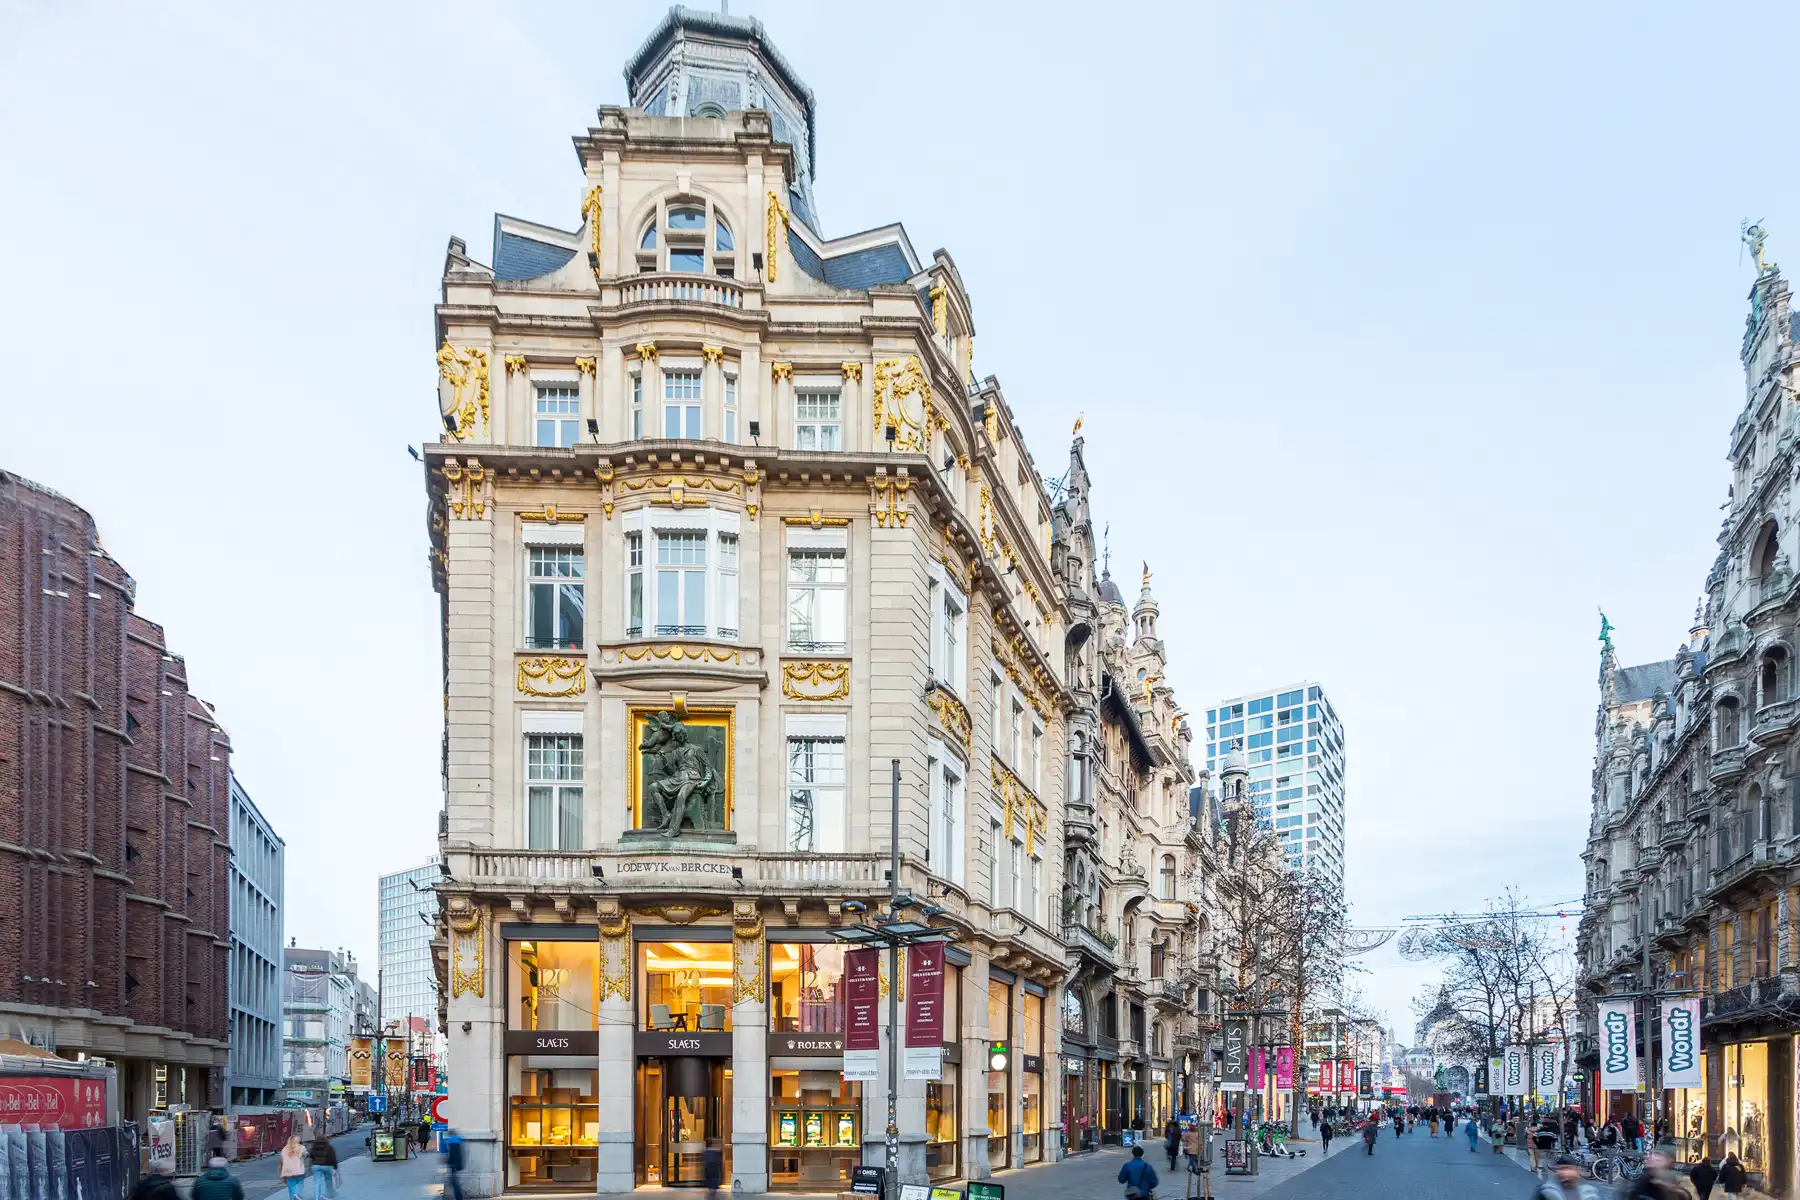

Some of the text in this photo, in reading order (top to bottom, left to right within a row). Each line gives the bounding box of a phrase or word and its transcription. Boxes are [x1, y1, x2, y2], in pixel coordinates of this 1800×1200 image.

[617, 862, 669, 873] LODEWYK
[681, 862, 733, 874] BERCKEN
[536, 1038, 569, 1048] SLAETS
[668, 1039, 700, 1049] SLAETS
[797, 1041, 832, 1050] ROLEX
[1226, 1028, 1242, 1074] SLAETS
